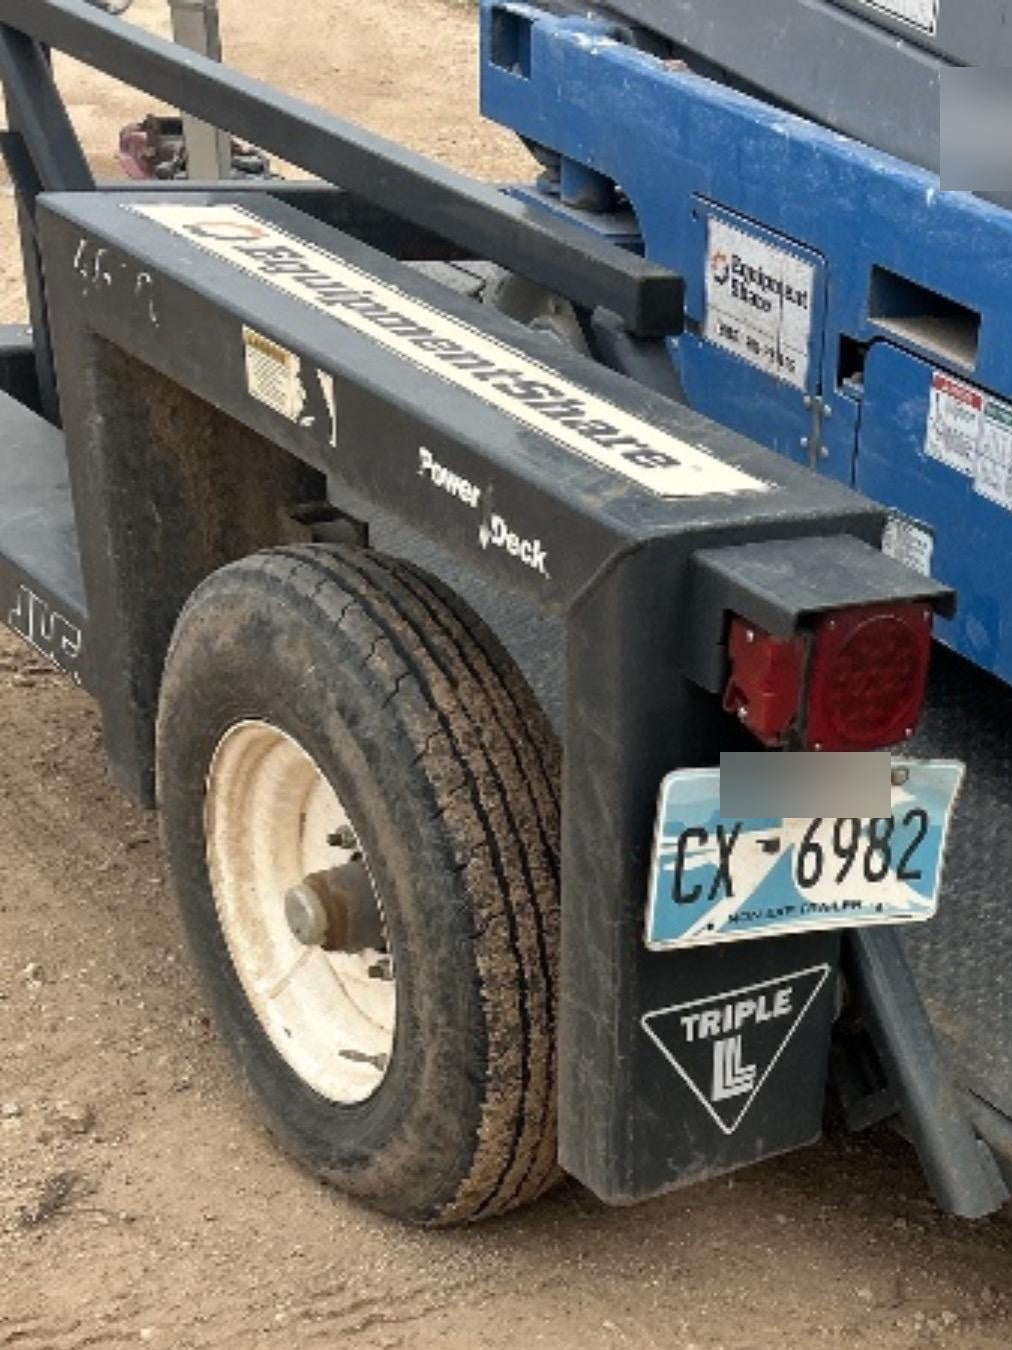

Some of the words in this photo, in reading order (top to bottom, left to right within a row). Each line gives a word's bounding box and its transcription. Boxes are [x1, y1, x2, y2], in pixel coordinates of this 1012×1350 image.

[232, 245, 682, 468] EquipmentShare
[417, 446, 481, 508] Power
[491, 514, 547, 574] Deck
[680, 987, 793, 1042] TRIPLE
